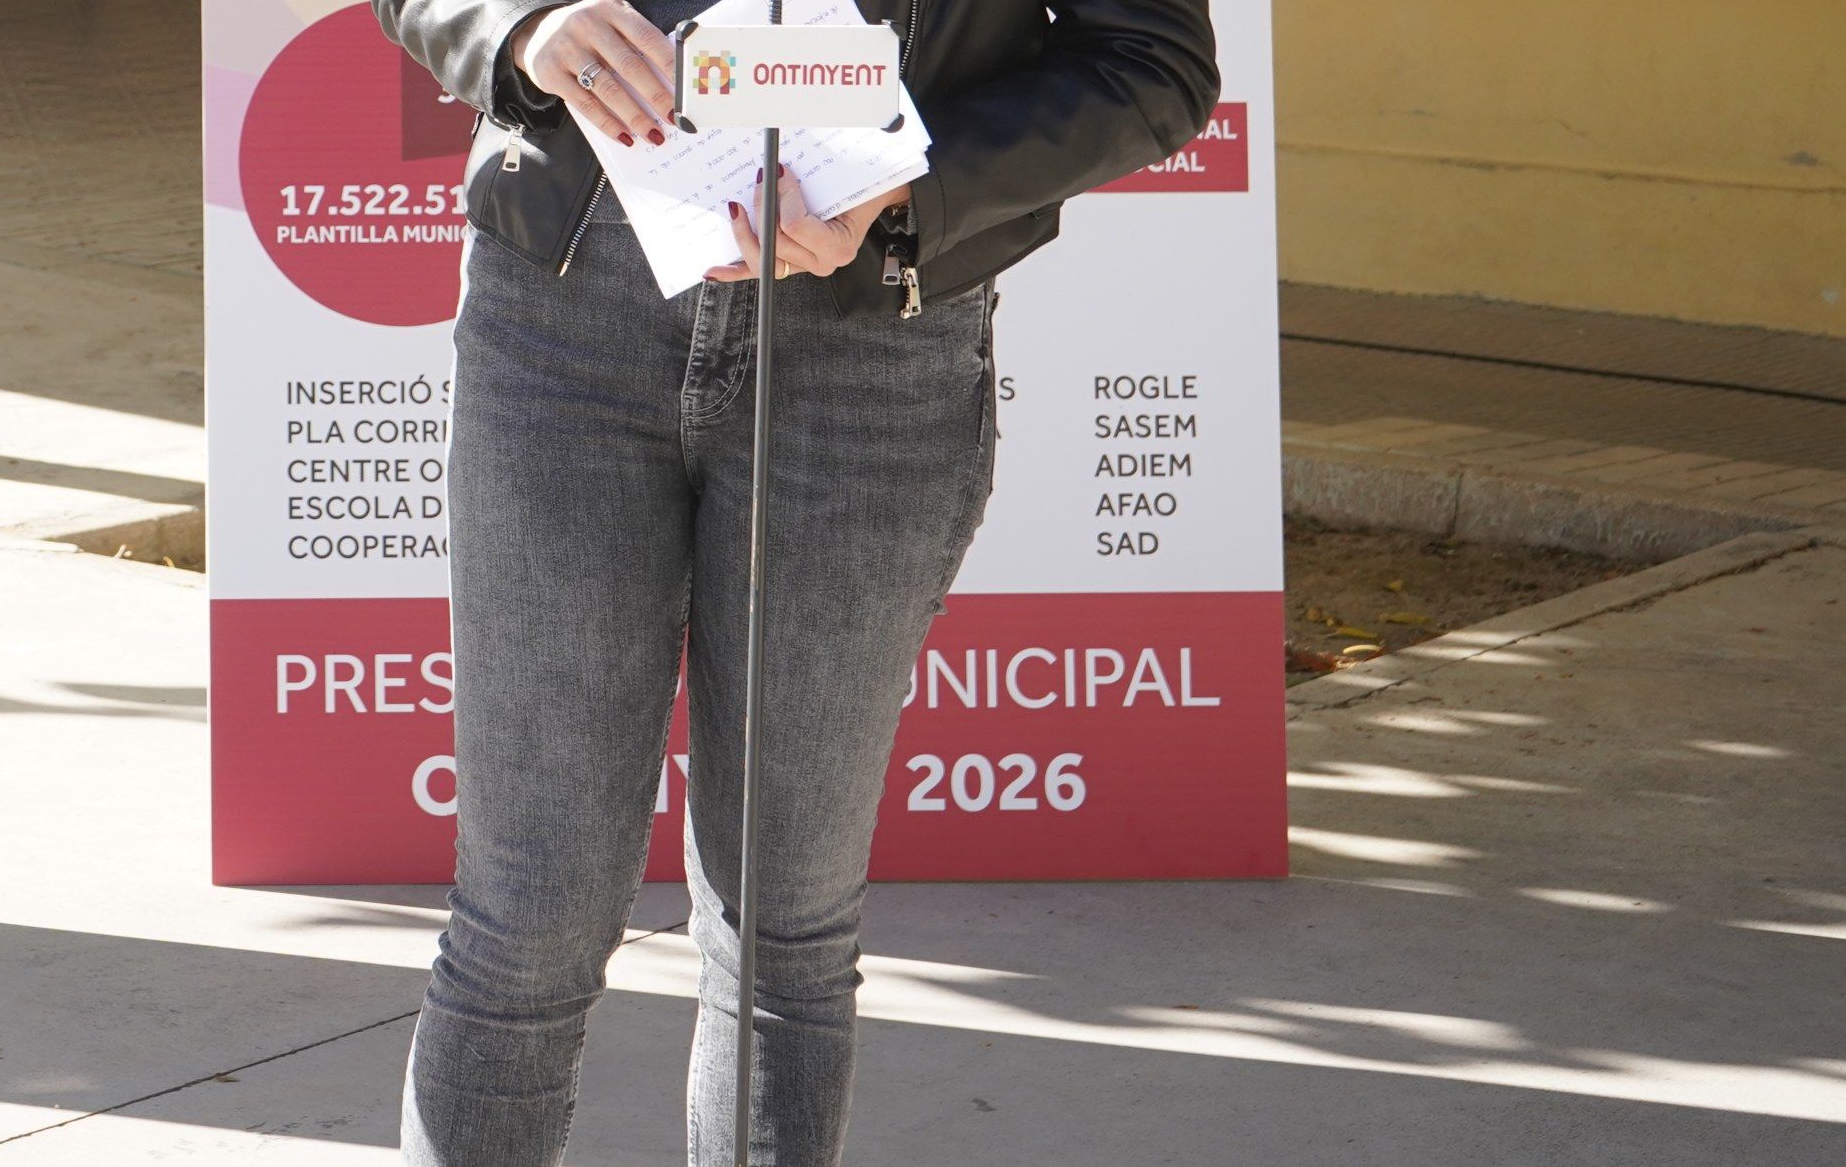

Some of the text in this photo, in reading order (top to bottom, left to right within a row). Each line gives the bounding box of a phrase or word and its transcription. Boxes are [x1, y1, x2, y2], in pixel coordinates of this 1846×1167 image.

[753, 63, 887, 86] ONTINYENT
[277, 225, 403, 244] PLANTILLA
[287, 374, 432, 405] INSERCIÓ
[1094, 375, 1199, 400] ROGLE
[288, 420, 345, 444] PLA
[1094, 414, 1197, 439] SASEM
[288, 459, 411, 483] CENTRE
[1094, 453, 1193, 478] ADIEM
[288, 496, 413, 520] ESCOLA
[1095, 492, 1178, 517] AFAO
[1097, 532, 1160, 556] SAD
[906, 752, 1087, 813] 2026
